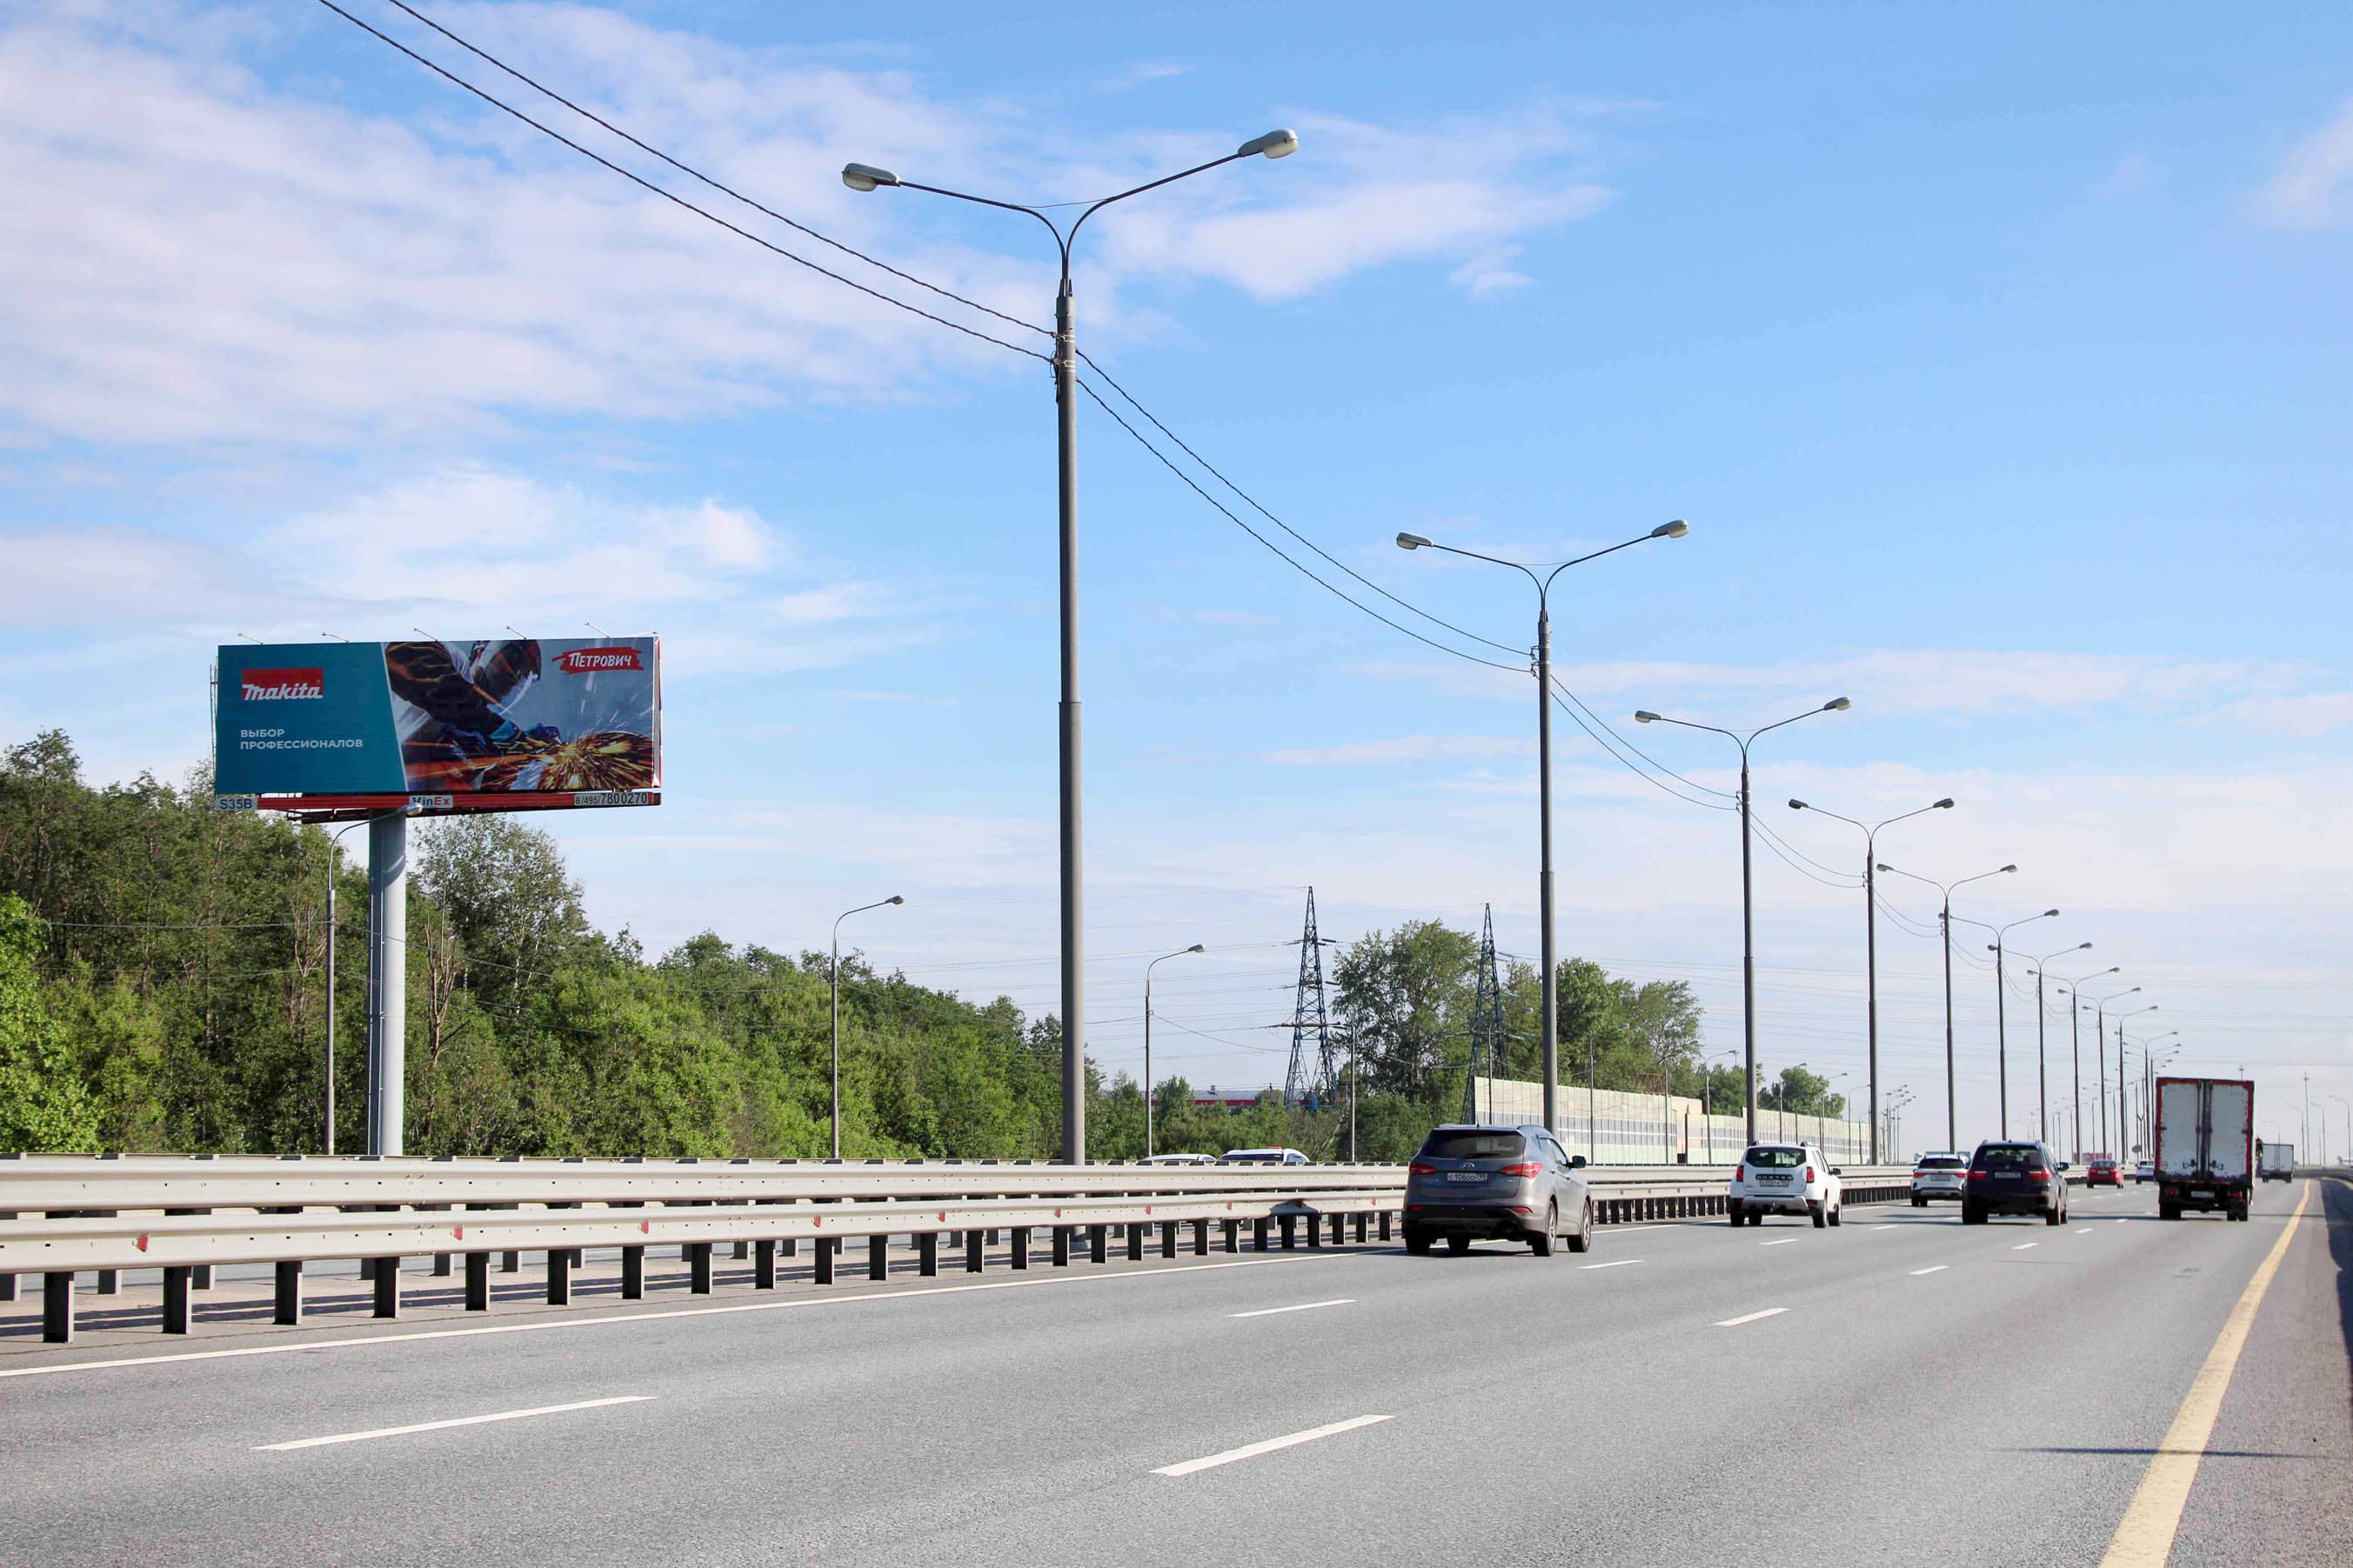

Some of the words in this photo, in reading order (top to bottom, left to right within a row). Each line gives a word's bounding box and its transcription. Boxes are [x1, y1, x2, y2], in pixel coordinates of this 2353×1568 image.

[240, 729, 285, 737] ВЫБОР
[240, 739, 364, 750] ПРОФЕССИОНАЛОВ
[219, 798, 252, 810] S35B
[412, 797, 451, 805] VinEx
